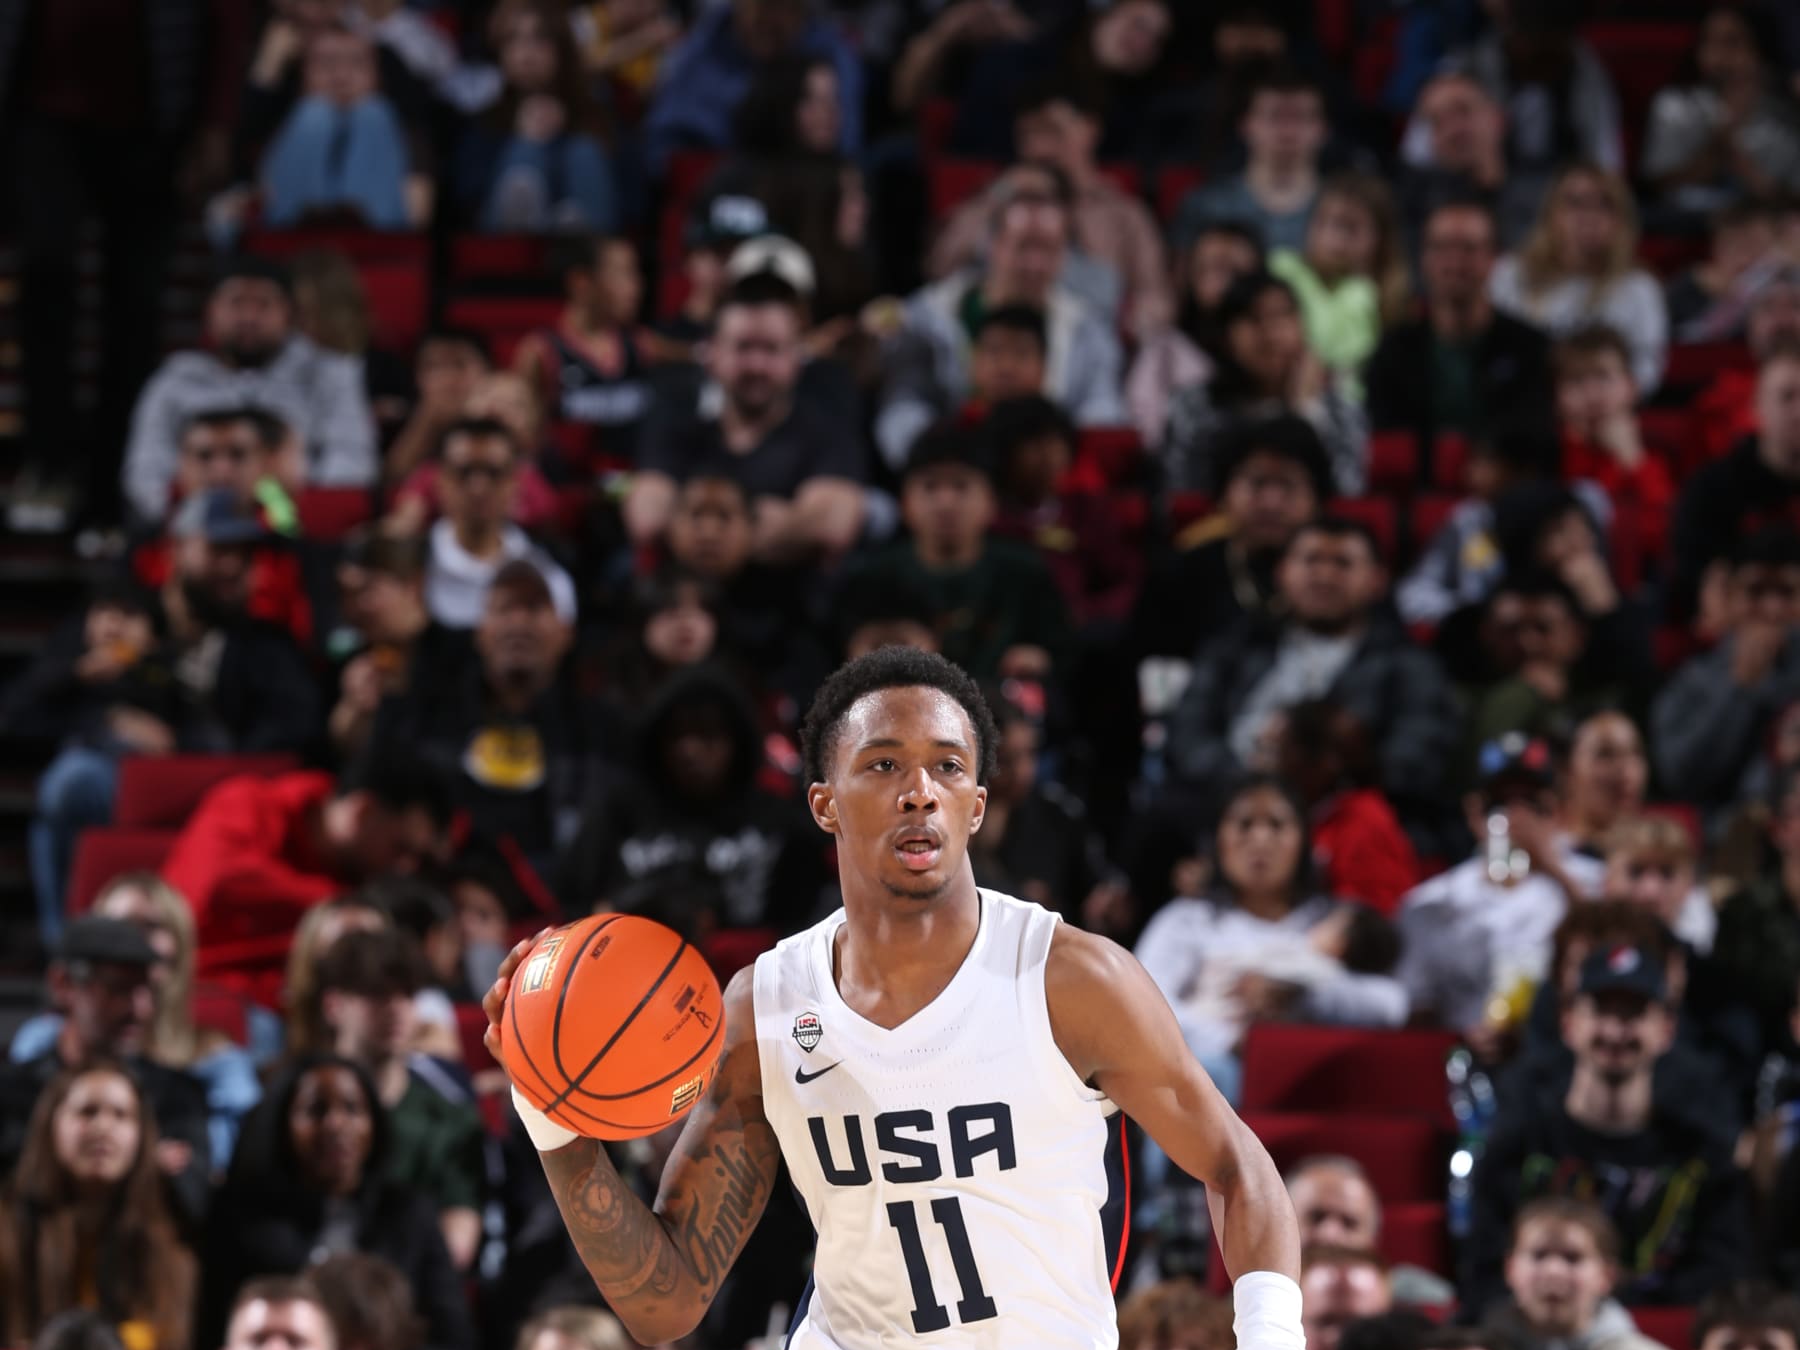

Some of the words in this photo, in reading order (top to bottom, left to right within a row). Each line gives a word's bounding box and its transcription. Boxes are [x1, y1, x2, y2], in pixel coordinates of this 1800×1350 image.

[807, 1101, 1017, 1187] USA
[684, 1144, 768, 1291] Family
[886, 1196, 998, 1334] 11
